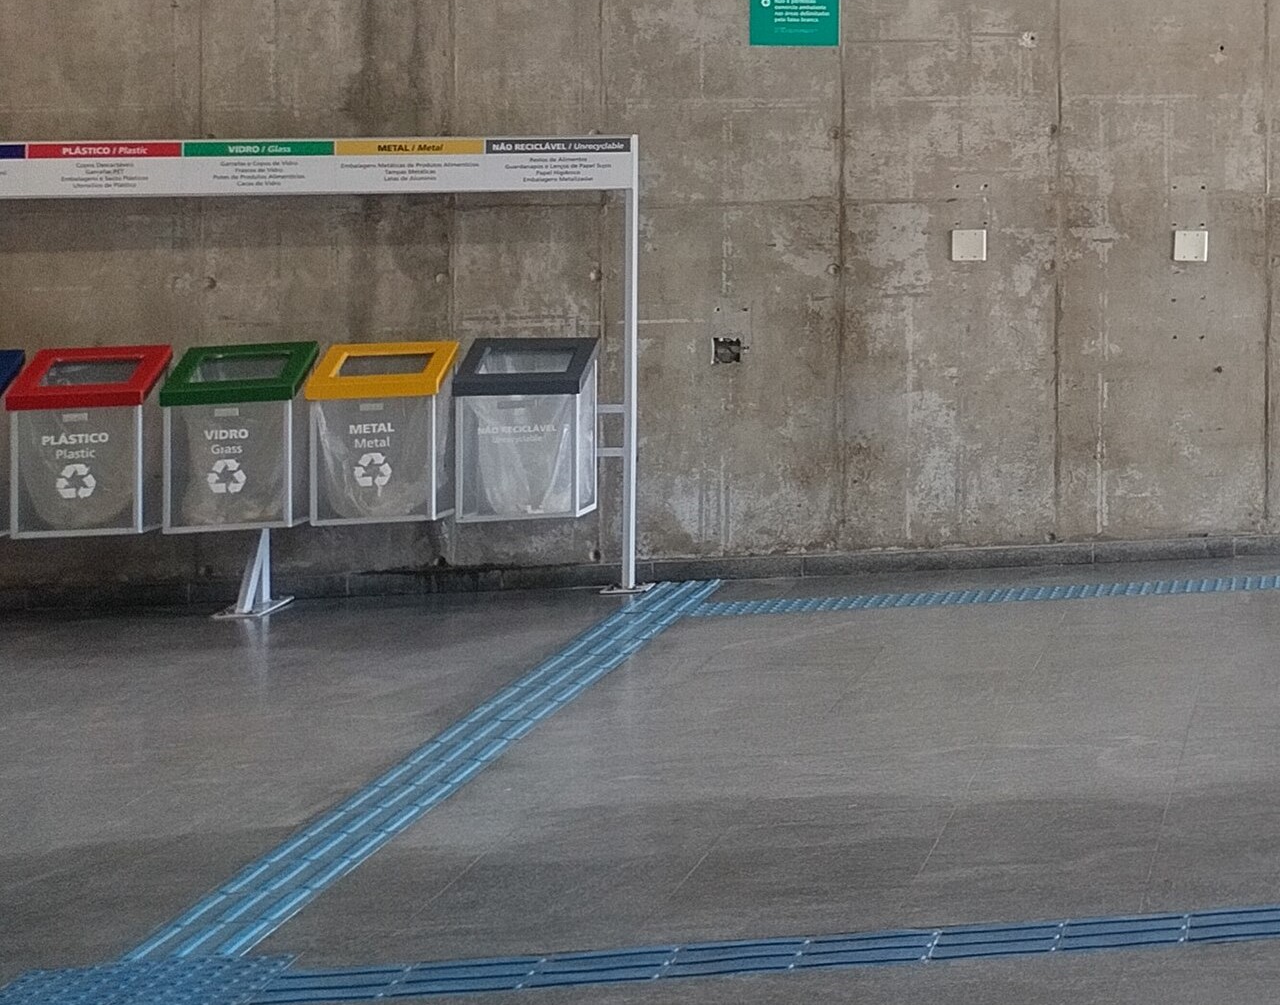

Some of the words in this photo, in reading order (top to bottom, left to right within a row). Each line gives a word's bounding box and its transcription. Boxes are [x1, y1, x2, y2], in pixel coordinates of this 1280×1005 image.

[62, 146, 110, 155] PLÁSTICO
[117, 146, 148, 154] Plastic
[228, 145, 260, 153] VIDRO
[267, 145, 292, 153] Glass
[377, 144, 410, 152] METAL
[492, 142, 513, 151] NÃO
[514, 142, 567, 151] RECICLÁVEL
[573, 142, 625, 151] Unrecyclable
[204, 428, 249, 441] VIDRO
[349, 422, 395, 435] METAL
[41, 432, 110, 446] PLÁSTICO
[354, 436, 390, 449] Metal
[55, 447, 96, 459] Plastic
[210, 443, 243, 455] Glass
